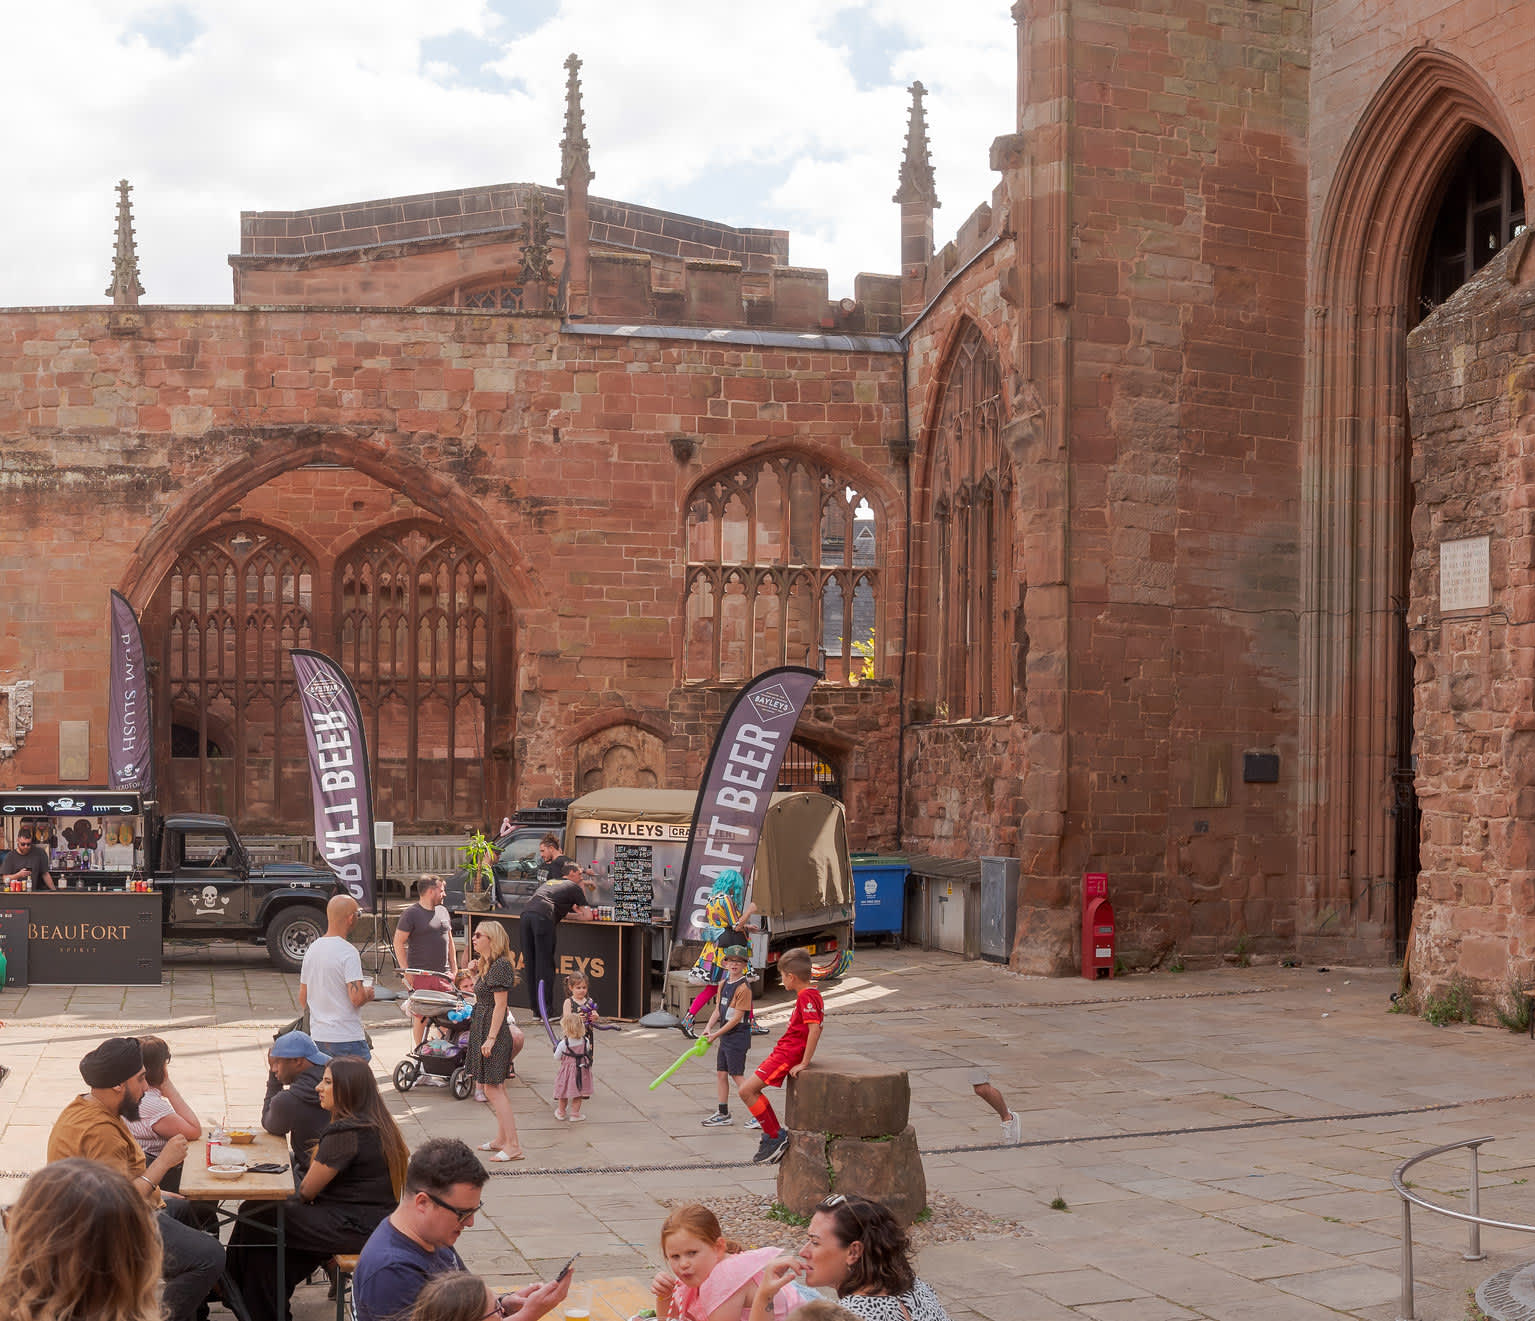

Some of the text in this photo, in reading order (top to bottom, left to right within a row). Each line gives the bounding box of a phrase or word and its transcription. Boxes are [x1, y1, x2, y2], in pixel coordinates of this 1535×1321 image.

[122, 690, 136, 752] SLUSH
[754, 695, 789, 711] BAYLEYS
[715, 723, 780, 813] BEER
[600, 822, 664, 837] BAYLEYS
